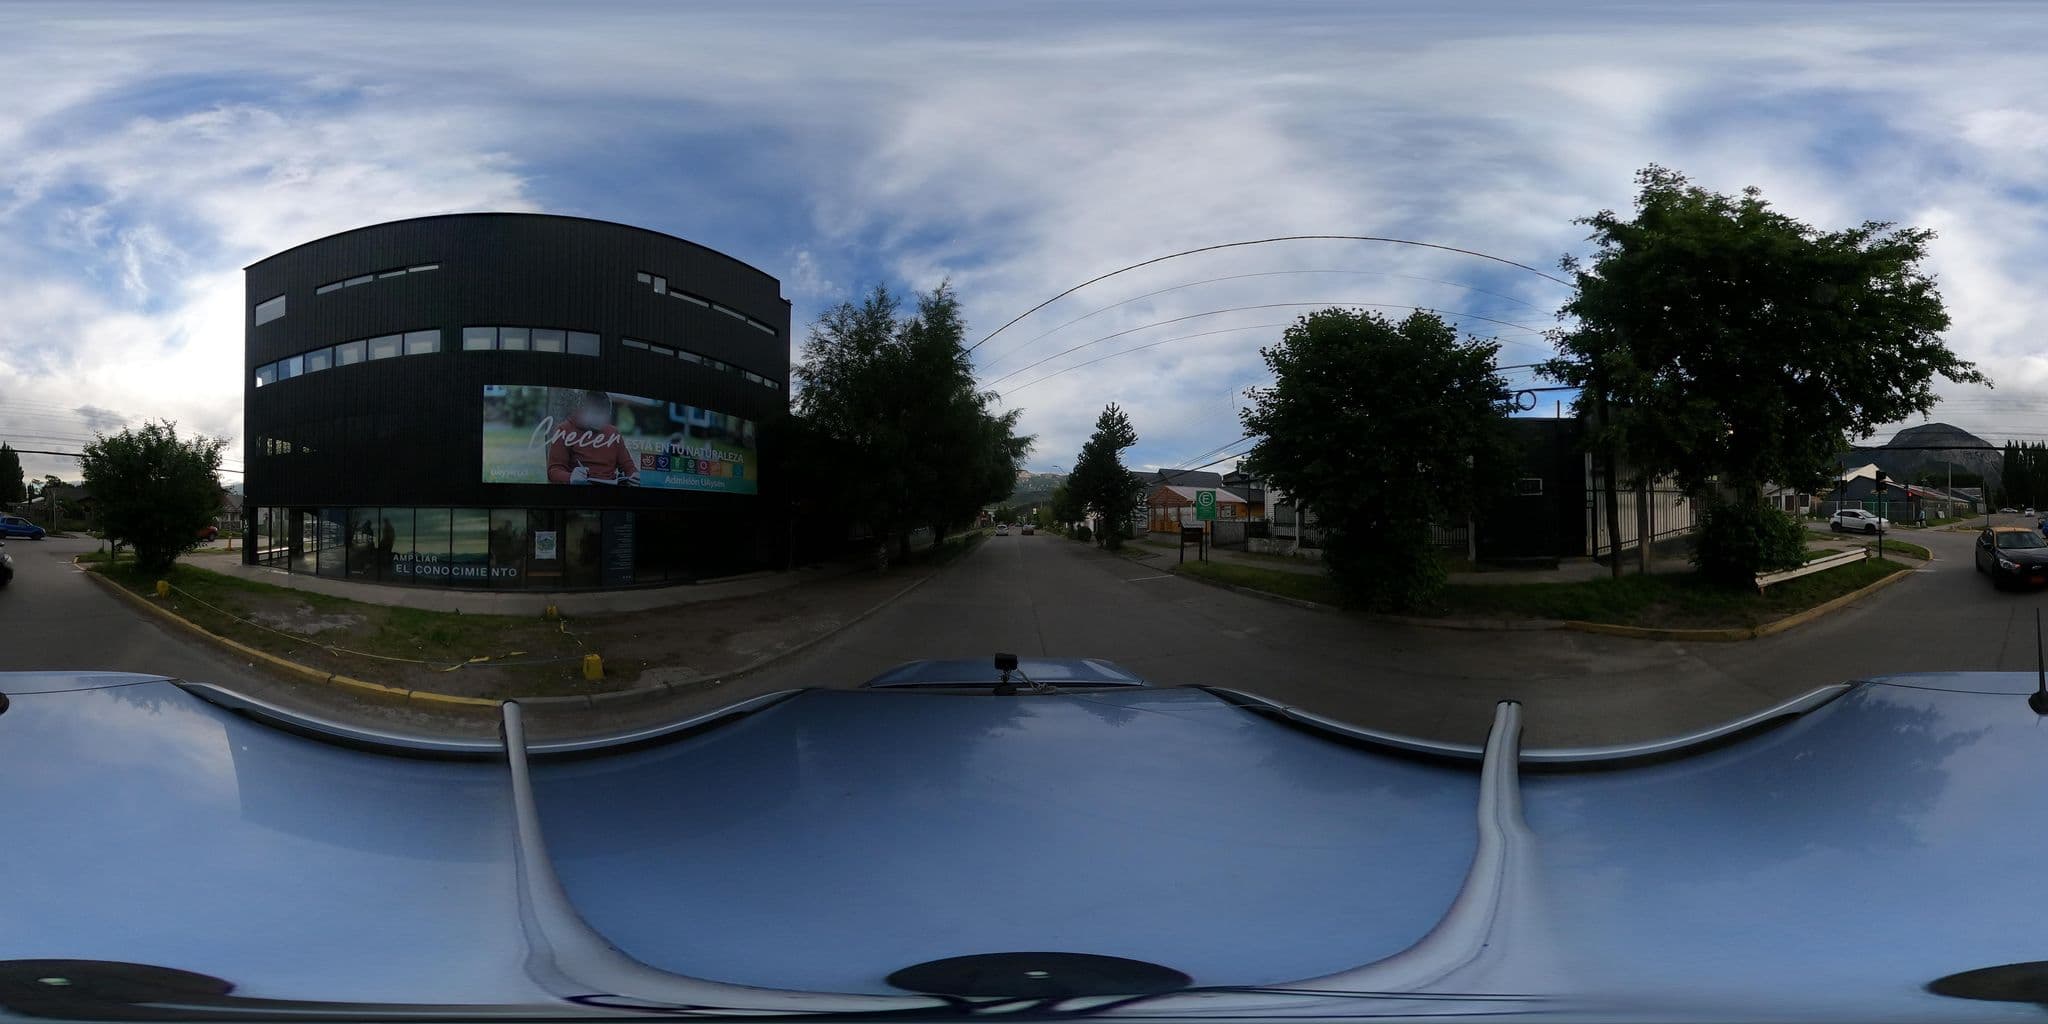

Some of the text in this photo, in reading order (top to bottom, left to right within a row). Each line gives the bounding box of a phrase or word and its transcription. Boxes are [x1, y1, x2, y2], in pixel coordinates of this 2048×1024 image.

[528, 415, 621, 449] Crecer
[655, 441, 670, 454] EN
[686, 445, 744, 464] NATURALEZA
[393, 554, 438, 563] AMPLIAR
[396, 564, 517, 577] EL CONOCIMIENTO
